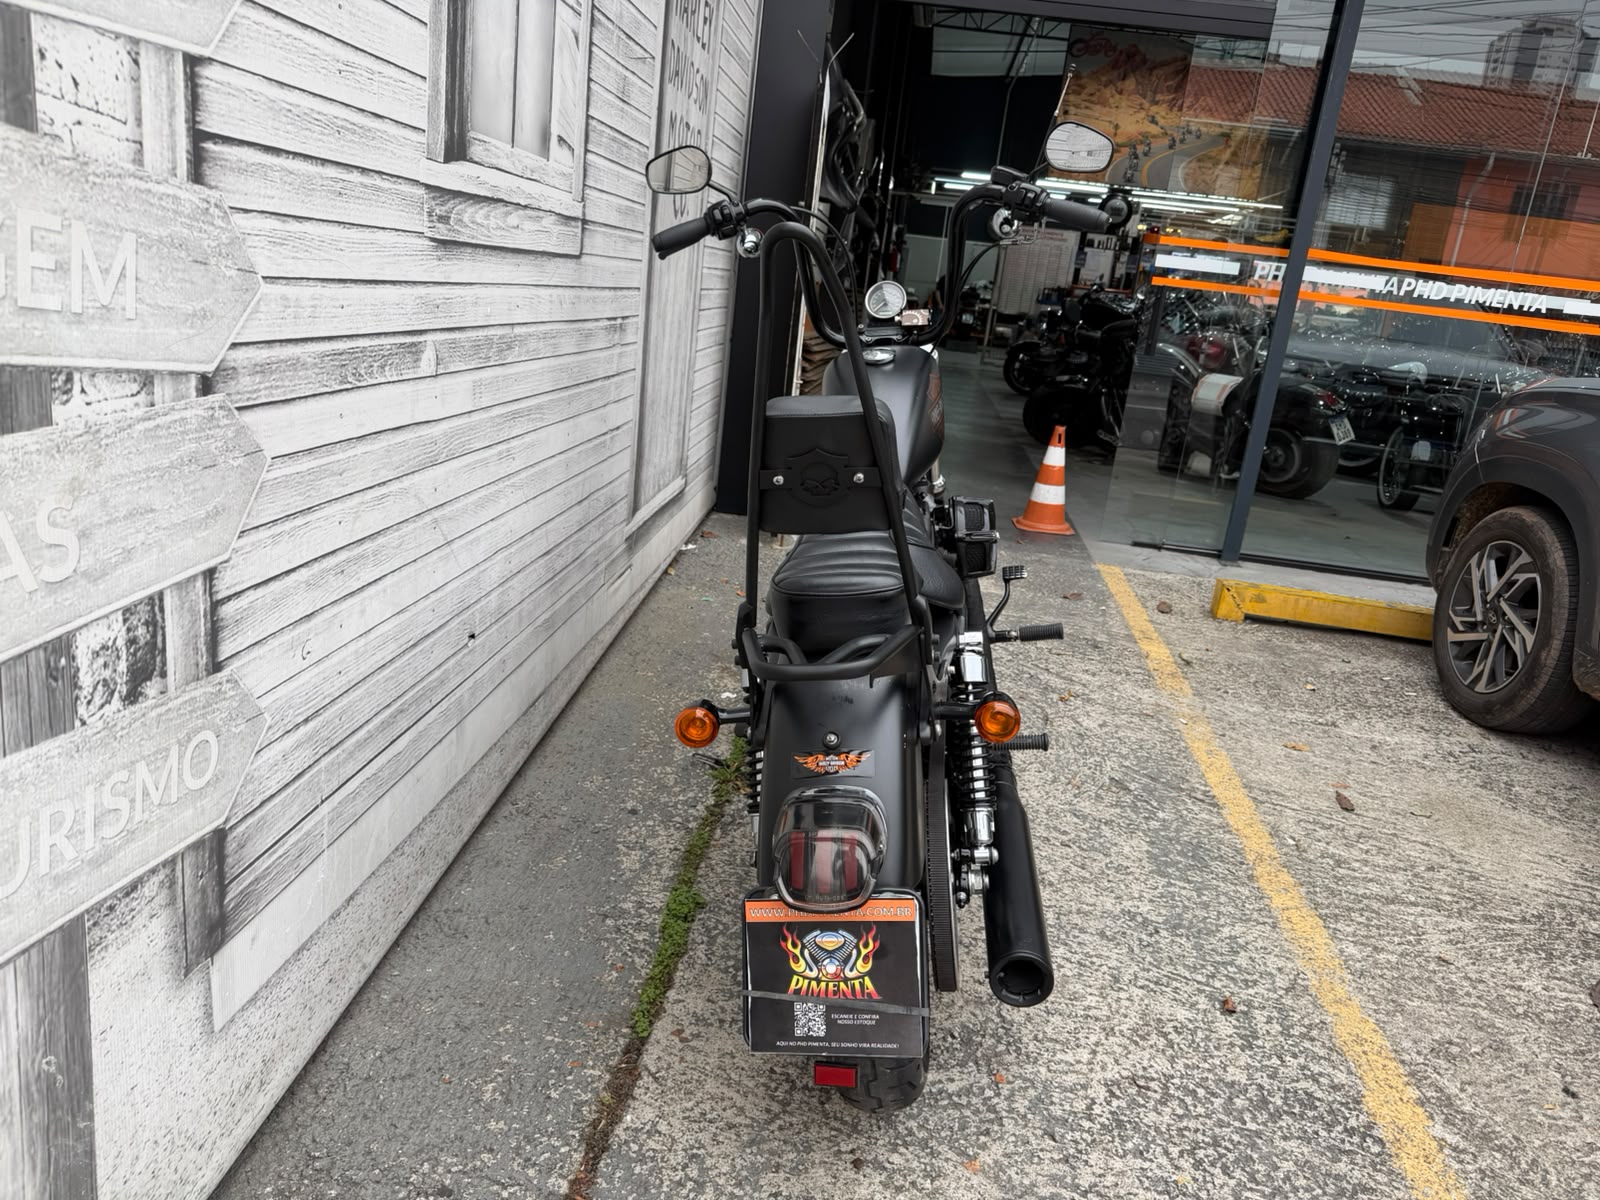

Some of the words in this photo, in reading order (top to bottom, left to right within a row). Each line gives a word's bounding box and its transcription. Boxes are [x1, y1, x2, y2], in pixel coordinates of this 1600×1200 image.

[668, 38, 709, 115] DAVIDSON
[0, 206, 137, 320] EM
[1399, 277, 1448, 301] PHD
[1450, 283, 1549, 313] PIMENTA
[749, 905, 913, 918] WWW.PHTA.COM.BR
[787, 974, 882, 999] PIMENTA
